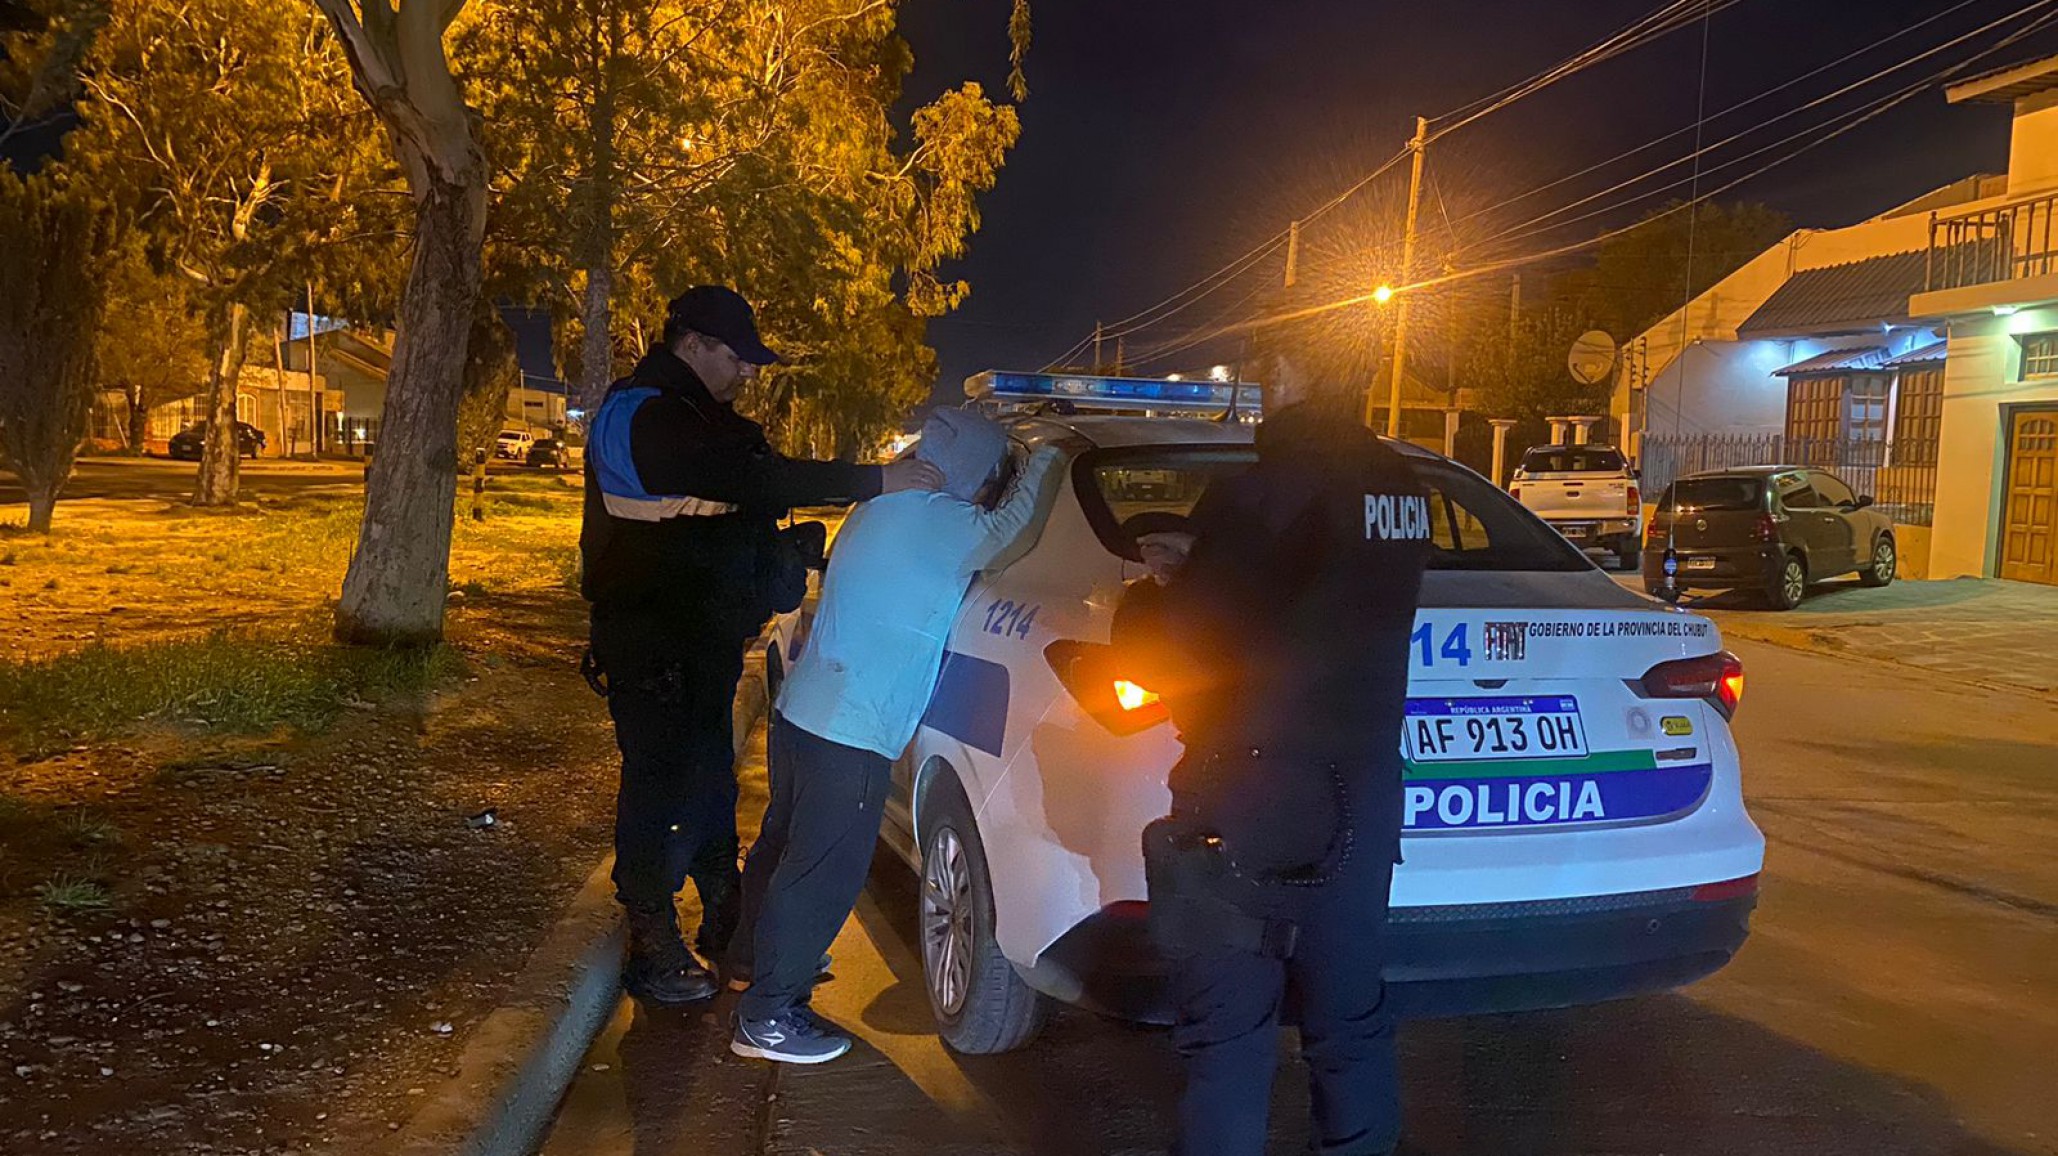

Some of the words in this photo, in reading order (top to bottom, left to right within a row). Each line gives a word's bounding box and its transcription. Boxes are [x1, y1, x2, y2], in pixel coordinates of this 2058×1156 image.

[1364, 493, 1430, 540] POLICIA
[983, 598, 1041, 640] 1214
[1529, 622, 1584, 637] GOBIERNO
[1586, 622, 1601, 637] DE
[1602, 622, 1615, 636] LA
[1617, 622, 1665, 636] PROVINCIA
[1667, 622, 1682, 636] DEL
[1683, 623, 1708, 637] CHUBUT
[1417, 718, 1455, 754] AF
[1466, 717, 1528, 753] 913
[1536, 715, 1579, 750] OH
[1403, 780, 1605, 826] POLICIA
